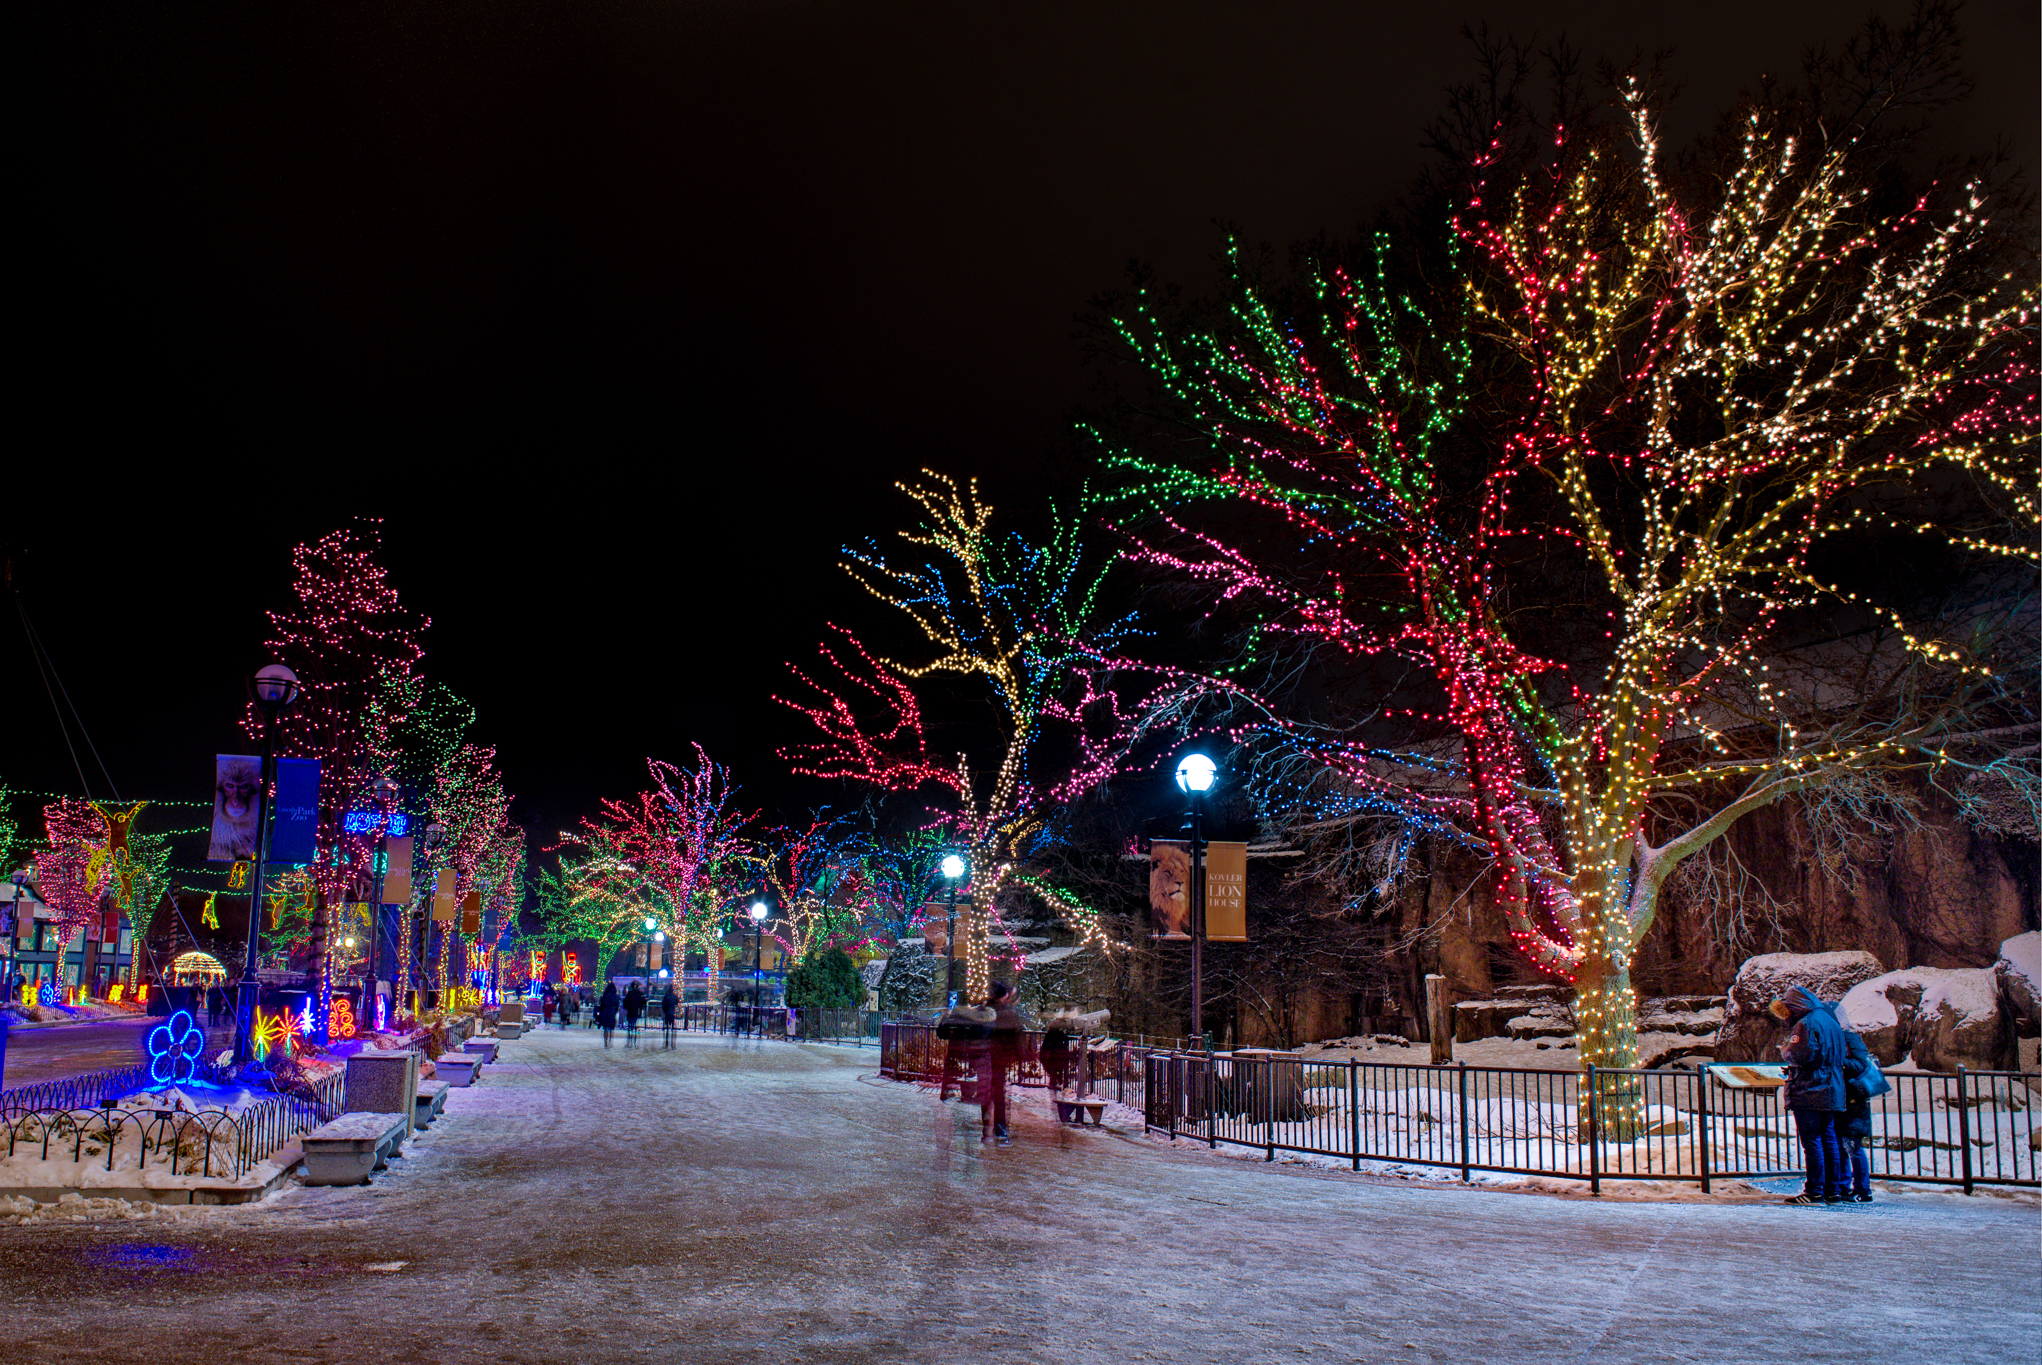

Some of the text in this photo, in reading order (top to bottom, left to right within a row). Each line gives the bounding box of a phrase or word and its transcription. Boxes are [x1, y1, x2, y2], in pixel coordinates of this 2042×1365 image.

[298, 806, 317, 816] Park
[290, 812, 308, 821] Zoo
[1208, 873, 1242, 882] KOVLER
[1209, 885, 1242, 897] LION
[1209, 898, 1242, 907] HOUSE
